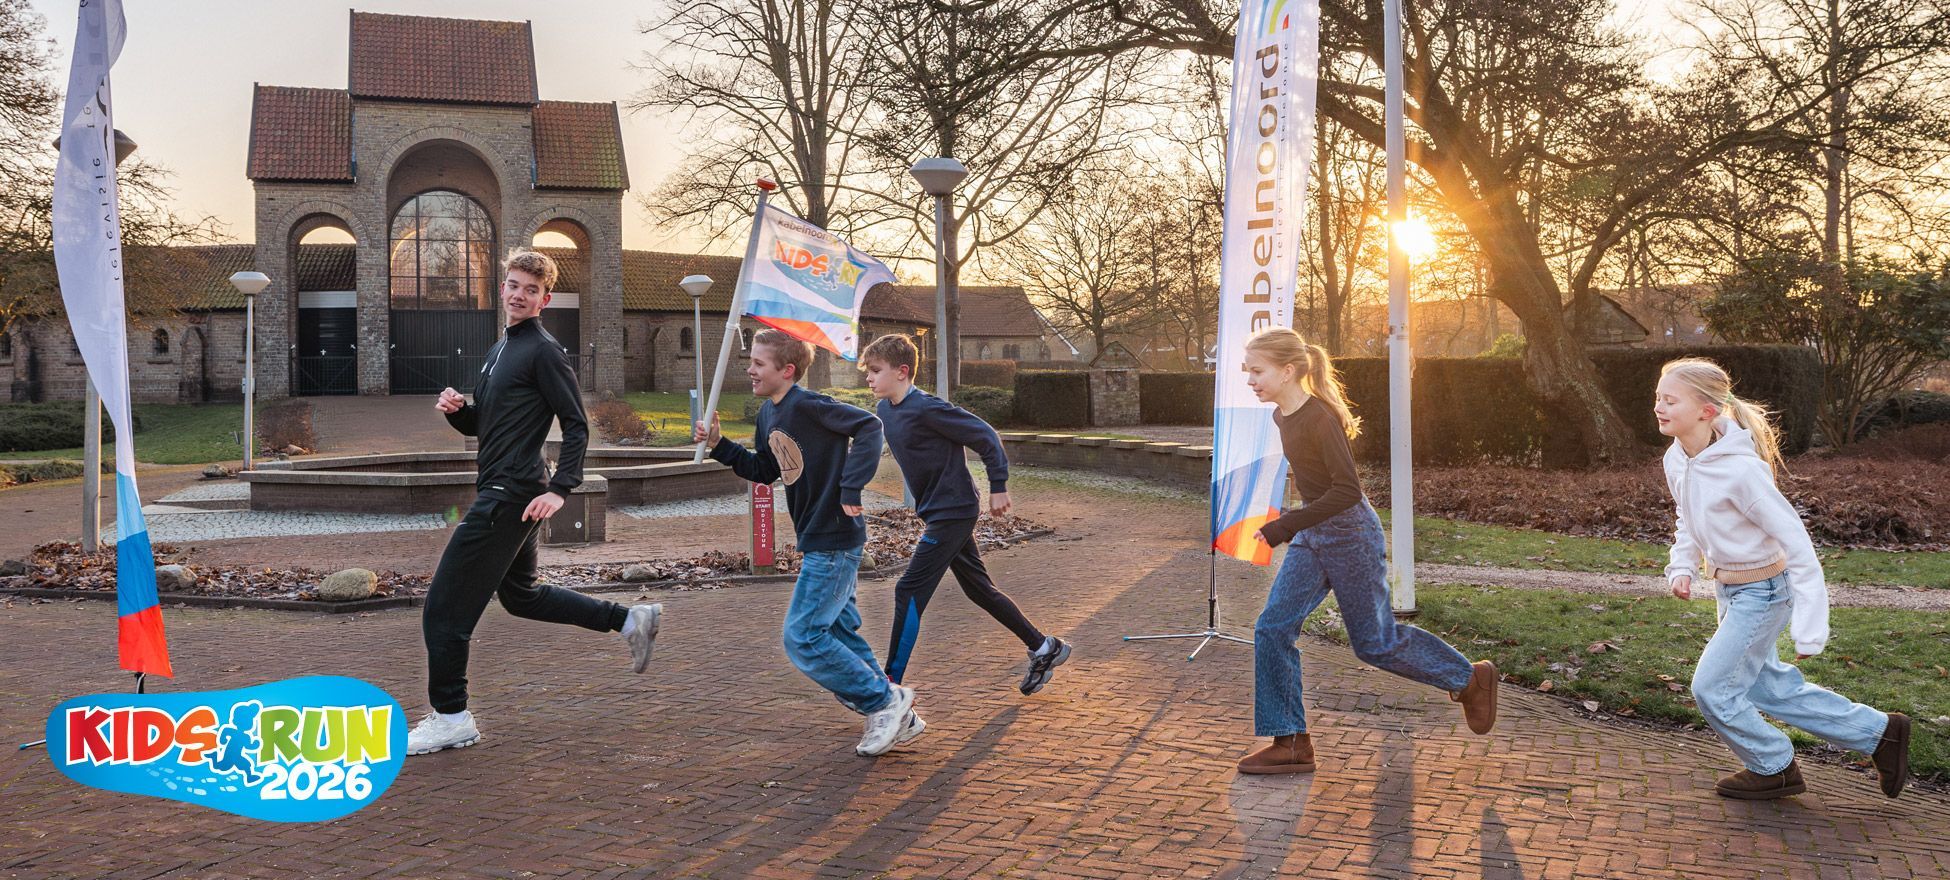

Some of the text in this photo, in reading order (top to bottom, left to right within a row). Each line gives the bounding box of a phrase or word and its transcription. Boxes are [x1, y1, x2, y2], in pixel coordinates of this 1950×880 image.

[1280, 43, 1289, 142] telefonie
[1242, 43, 1279, 372] abelnoord
[775, 240, 829, 276] KIDS
